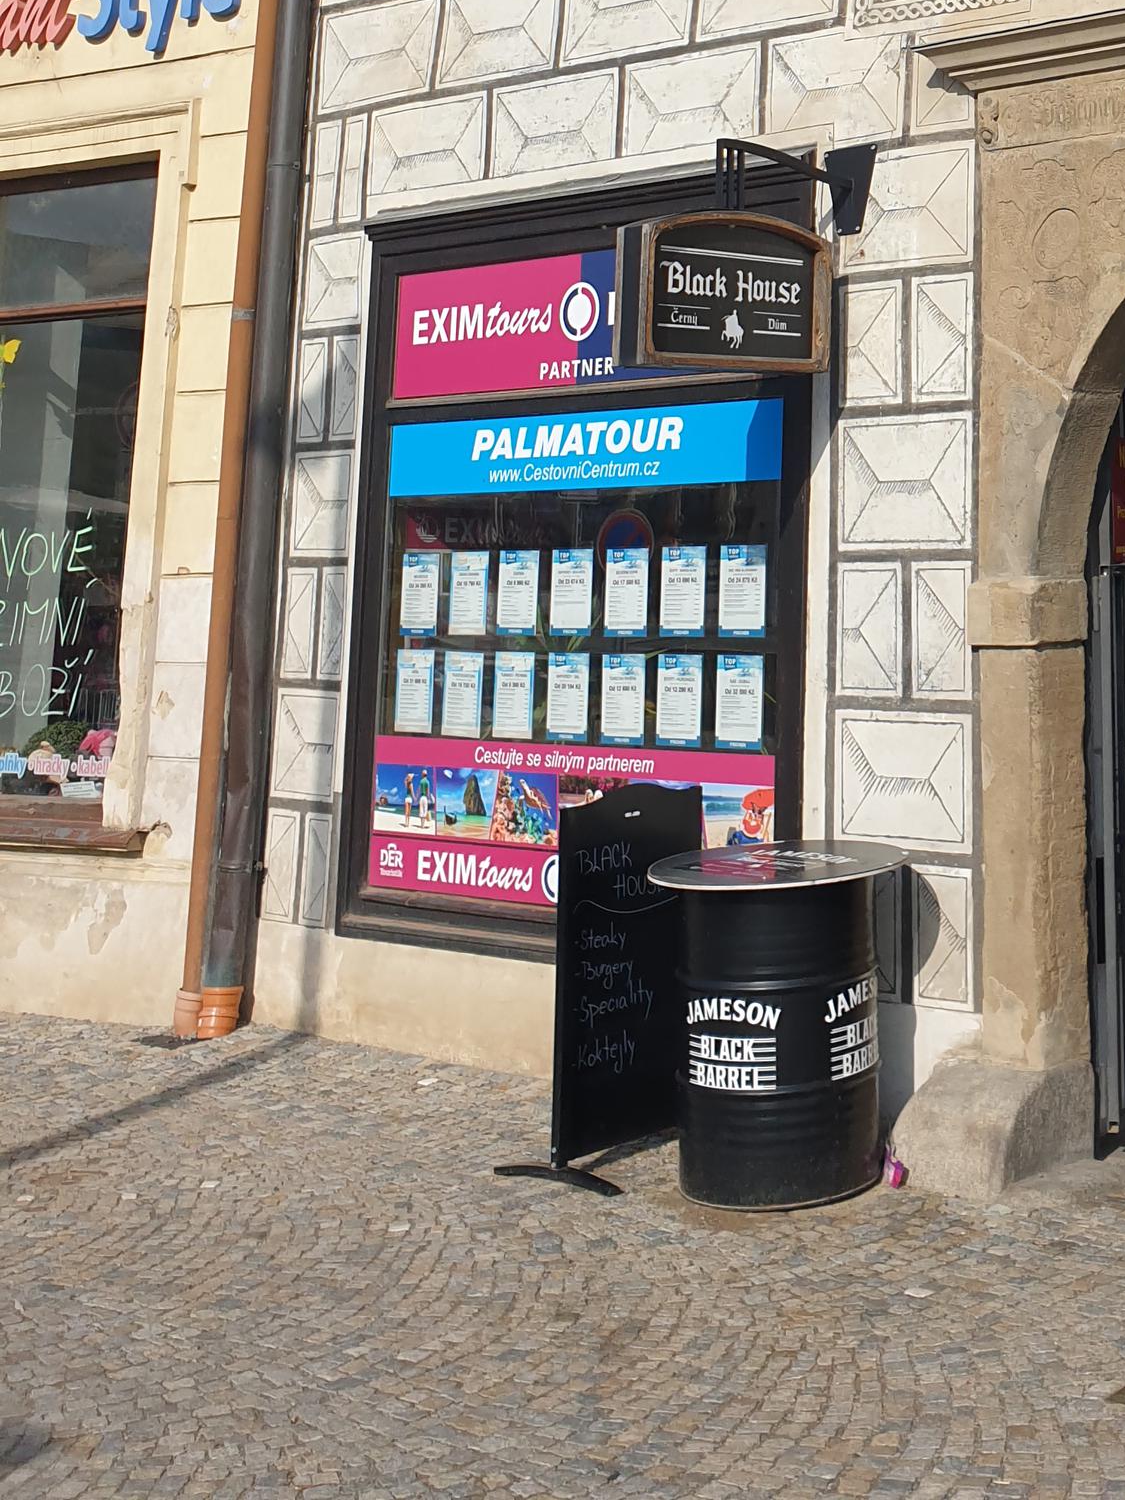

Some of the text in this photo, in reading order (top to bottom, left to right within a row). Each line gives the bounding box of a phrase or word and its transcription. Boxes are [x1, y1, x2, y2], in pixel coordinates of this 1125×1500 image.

[660, 261, 801, 304] Black House
[412, 301, 553, 346] EXIMtours
[671, 307, 787, 331] Černý Dům
[539, 356, 615, 381] PARTNER
[471, 416, 684, 462] PALMATOUR
[489, 460, 661, 484] www.CestovniCentrum.cz
[475, 746, 655, 774] Cestujte se silným partnerem
[417, 849, 533, 893] EXIMtours
[576, 841, 633, 874] BLACK
[686, 998, 781, 1030] JAMESON
[700, 1035, 756, 1062] BLACK
[697, 1063, 762, 1090] BARREL
